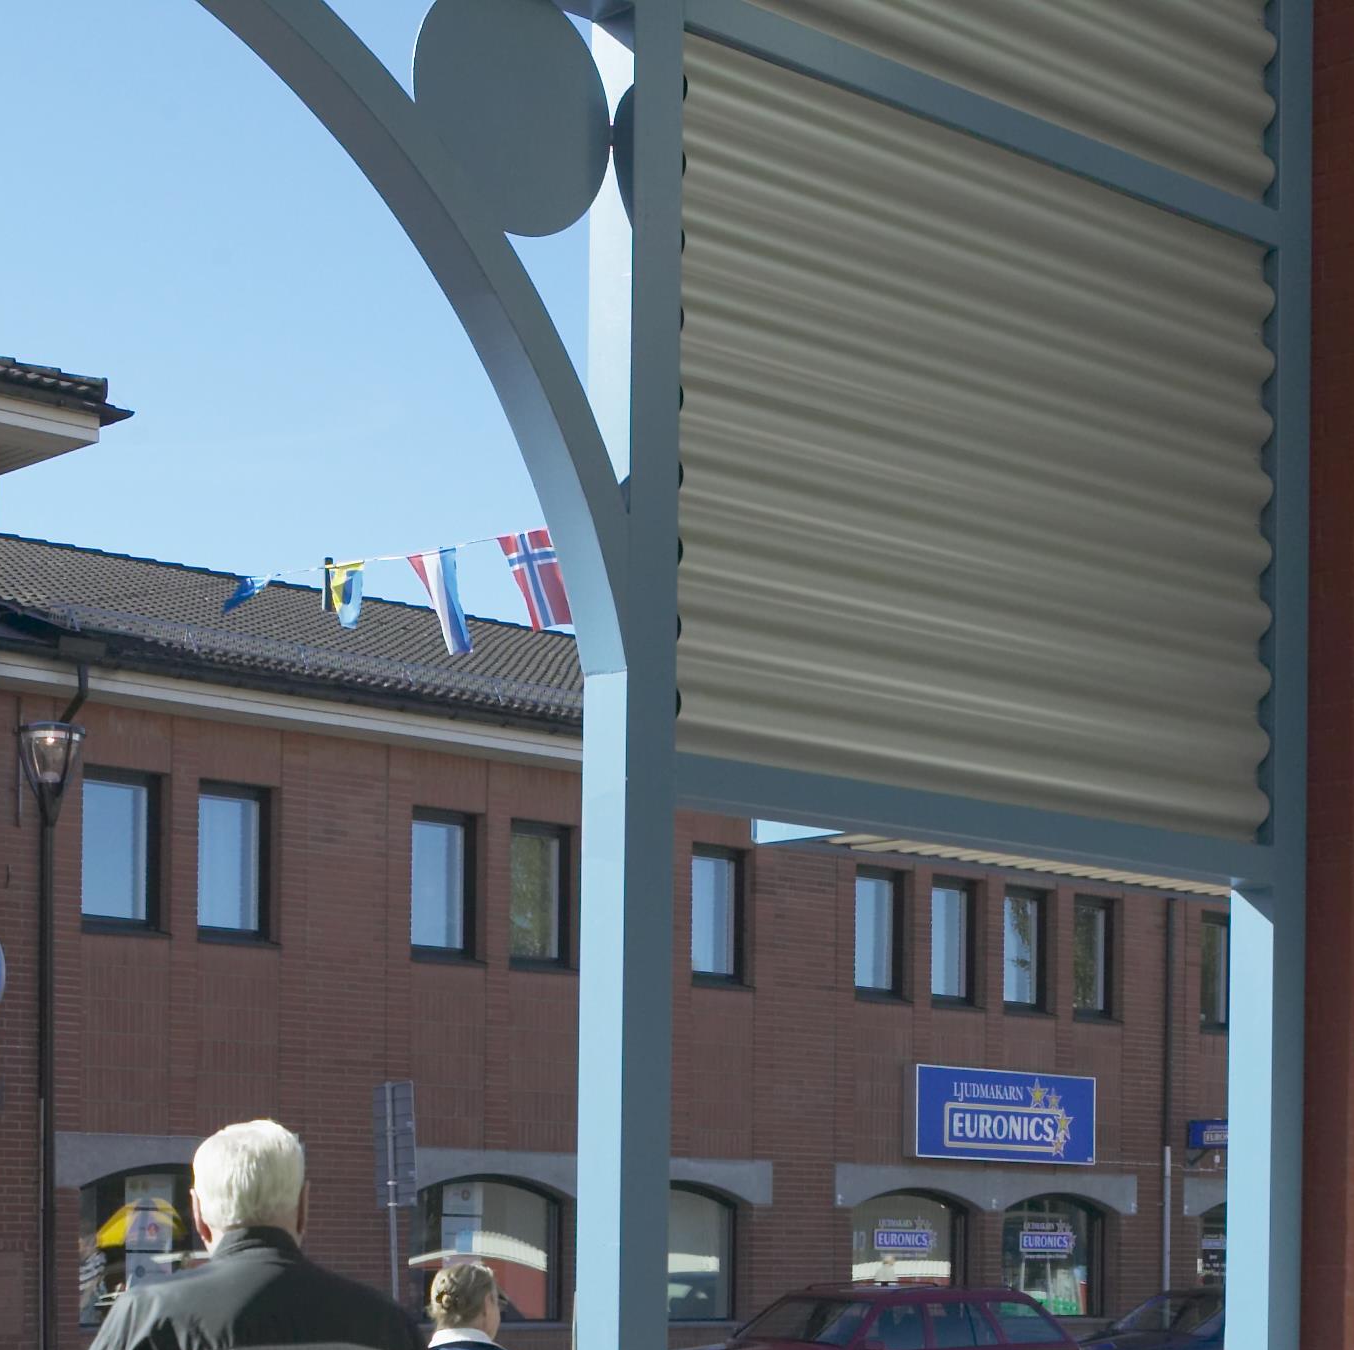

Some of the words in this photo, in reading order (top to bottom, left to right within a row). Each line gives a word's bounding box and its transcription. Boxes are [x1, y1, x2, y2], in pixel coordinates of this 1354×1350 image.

[953, 1082, 1024, 1101] LJUDMAKARN
[953, 1112, 1055, 1142] EURONICS
[878, 1232, 929, 1246] EURONICS
[1022, 1235, 1068, 1248] EURONICS
